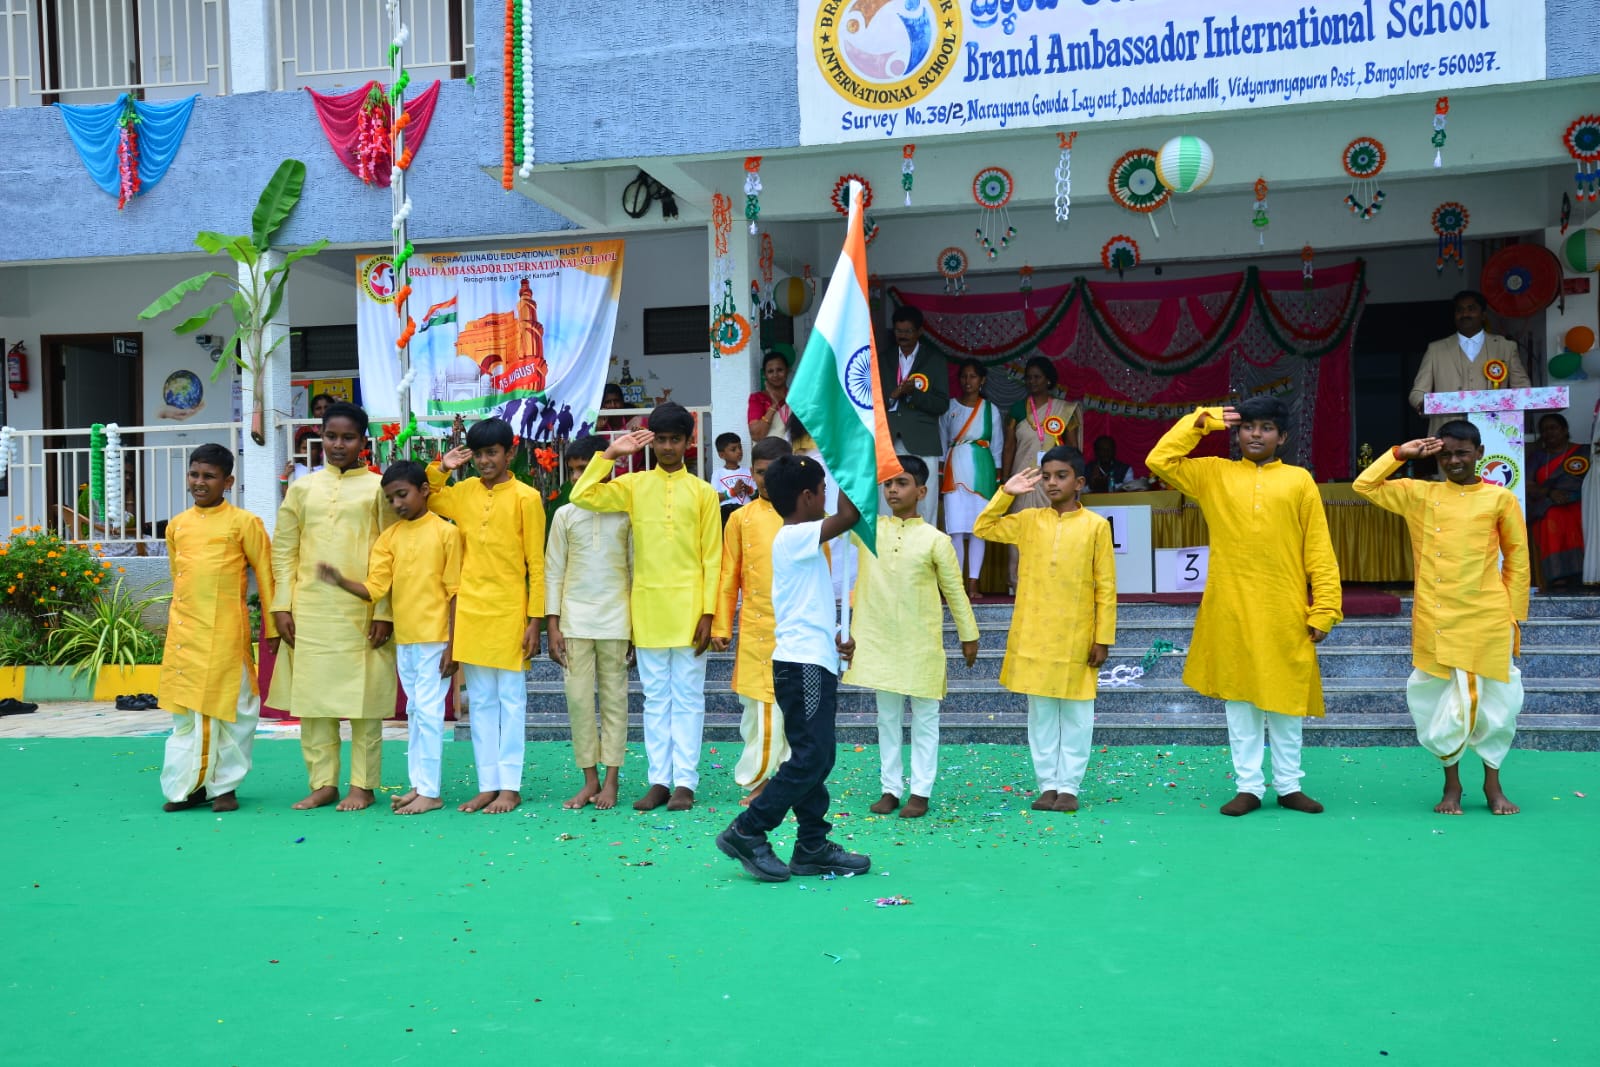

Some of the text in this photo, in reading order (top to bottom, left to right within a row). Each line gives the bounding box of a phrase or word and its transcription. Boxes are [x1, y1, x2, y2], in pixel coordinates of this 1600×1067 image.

[821, 0, 842, 27] BRA
[963, 0, 1490, 82] Brand Ambassador International School
[822, 34, 957, 103] INTERNATIONAL SCHOOL
[841, 111, 898, 136] Survey
[966, 98, 1029, 127] Narayana
[1032, 89, 1069, 116] Gowda
[1228, 75, 1327, 102] Vidyaranyapura
[440, 263, 501, 276] AMBASSADOR
[502, 258, 579, 273] INTERNATIONAL
[580, 252, 617, 266] SCHOOL
[501, 250, 554, 260] EDUCATIONAL
[555, 246, 580, 256] TRUST
[499, 362, 535, 391] 15 AUGUST
[1183, 553, 1200, 581] 3
